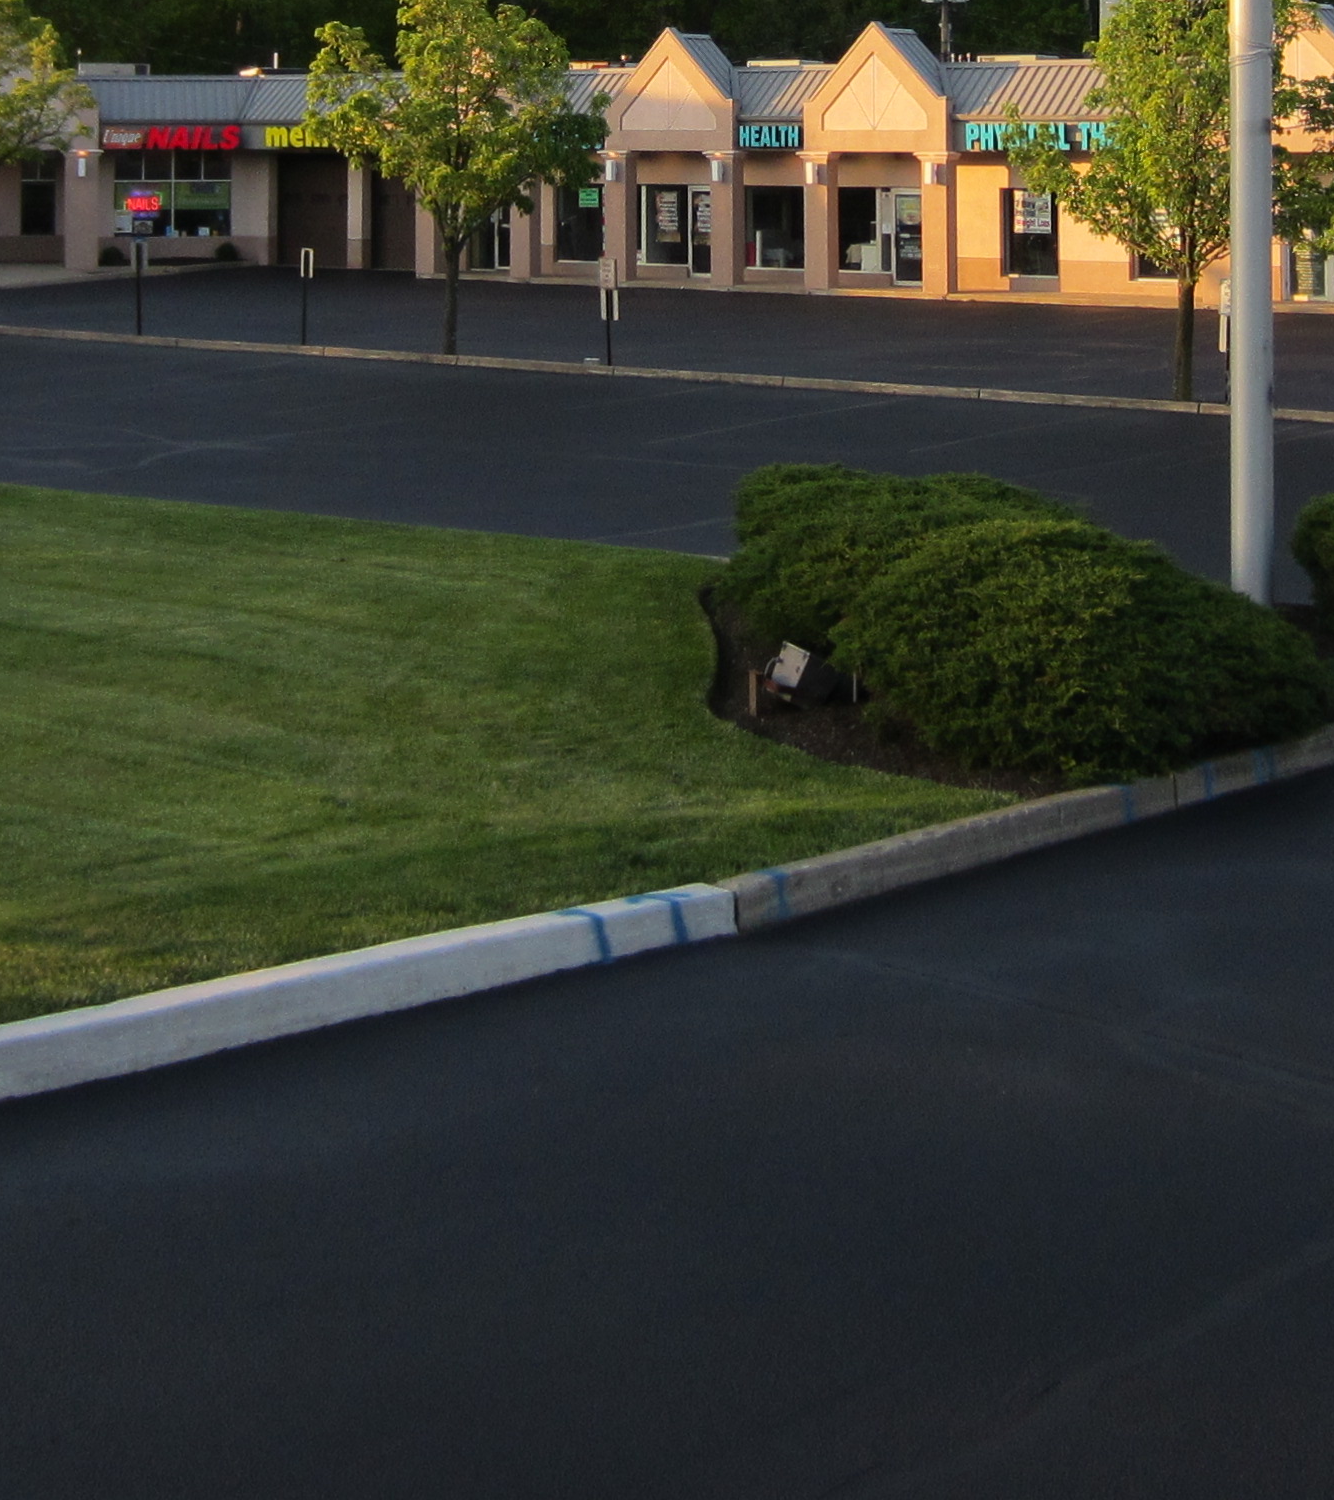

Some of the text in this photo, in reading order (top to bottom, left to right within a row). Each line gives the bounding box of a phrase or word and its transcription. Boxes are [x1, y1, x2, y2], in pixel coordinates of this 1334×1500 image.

[146, 125, 241, 150] NAILS
[739, 125, 799, 147] HEALTH
[127, 196, 160, 211] NAILS
